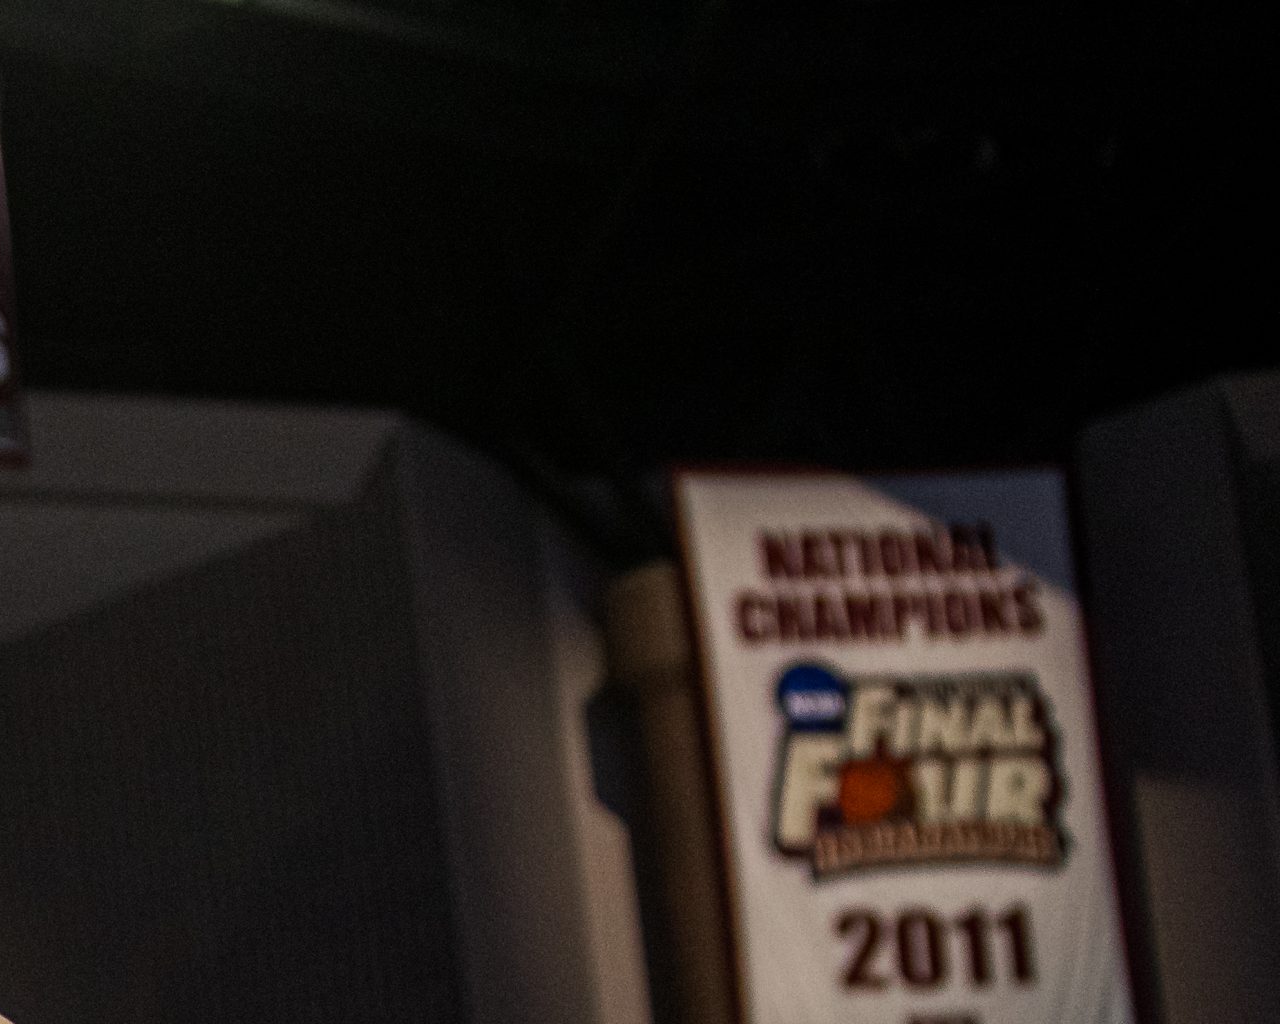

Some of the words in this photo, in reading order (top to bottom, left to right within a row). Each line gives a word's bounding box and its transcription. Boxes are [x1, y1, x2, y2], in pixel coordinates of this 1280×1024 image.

[762, 524, 997, 578] NATIONAL
[736, 580, 1043, 642] CHAMPIONS
[851, 688, 1047, 752] FINAL
[833, 903, 1038, 991] 2011
